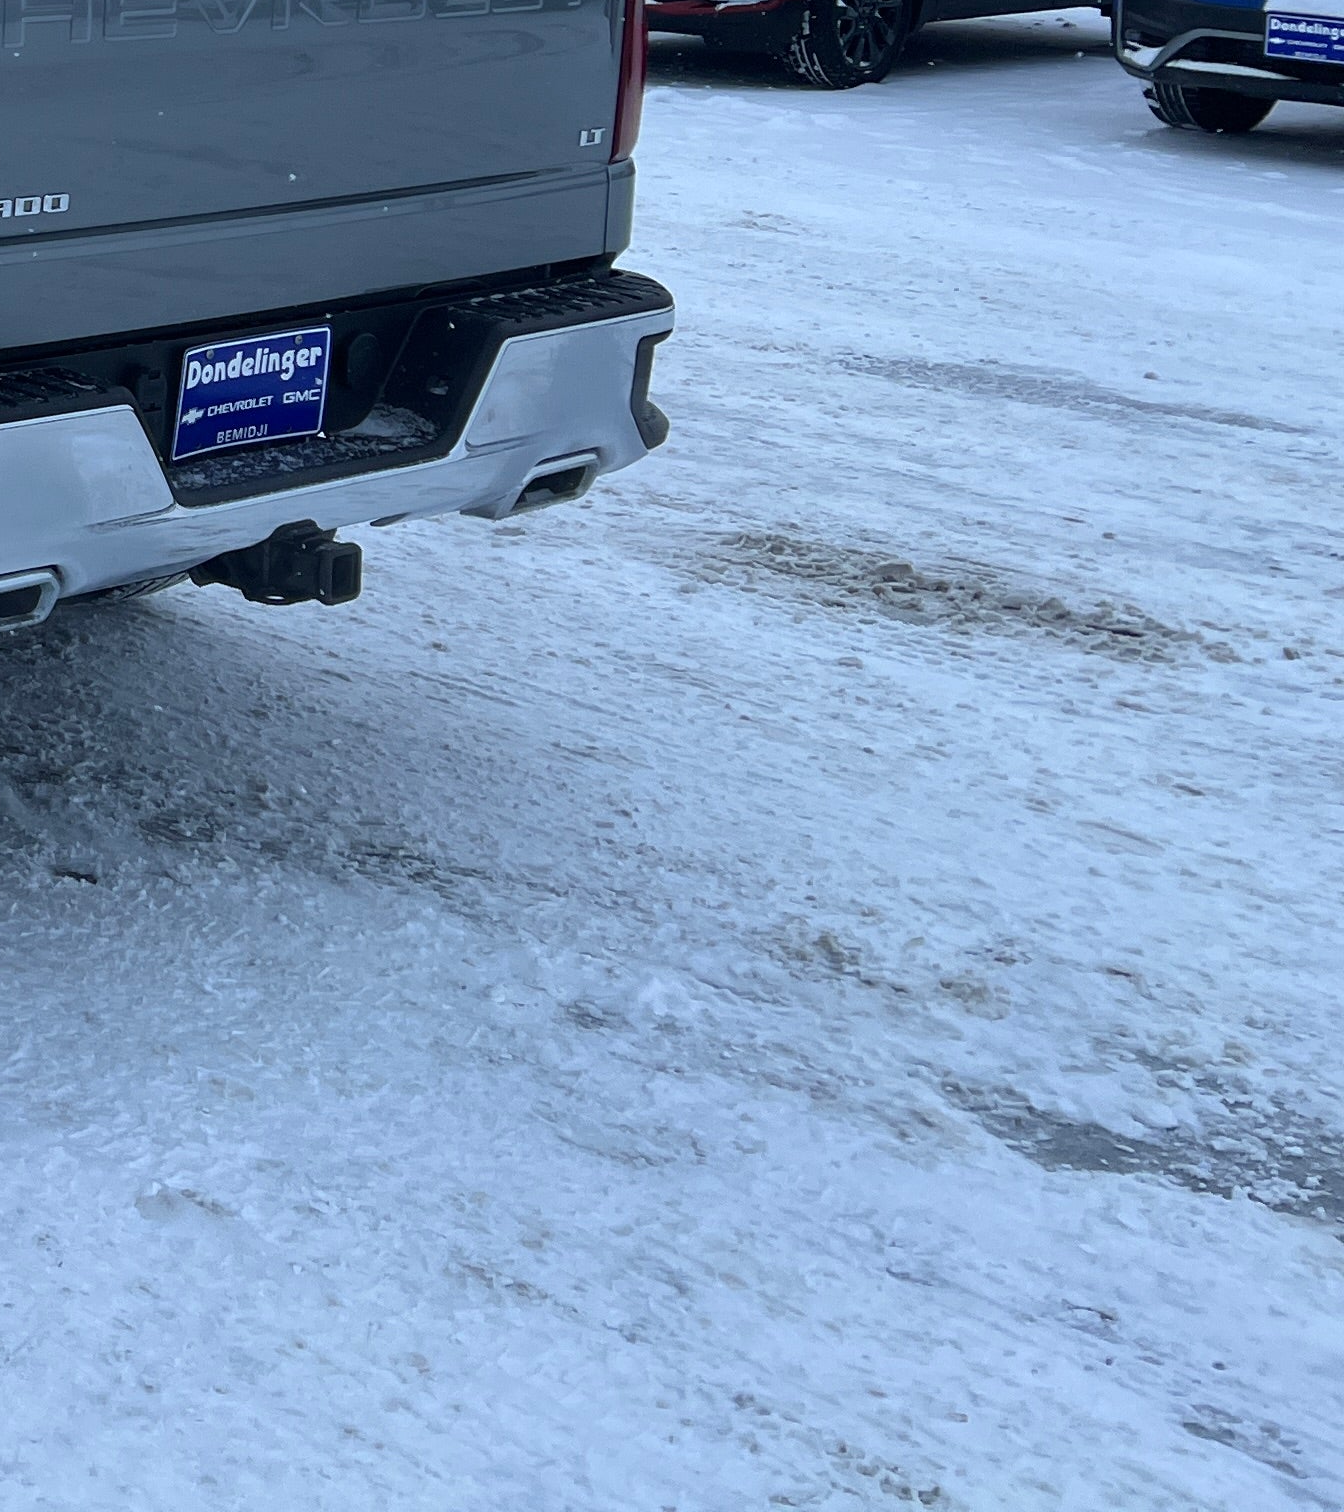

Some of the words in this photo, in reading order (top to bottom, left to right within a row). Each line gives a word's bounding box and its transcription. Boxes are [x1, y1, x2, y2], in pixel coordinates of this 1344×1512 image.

[579, 127, 606, 147] LT
[187, 347, 322, 389] Dondelinger
[207, 396, 274, 417] CHEVROLET
[283, 389, 321, 404] GMC
[216, 424, 268, 443] BEMIDJI
